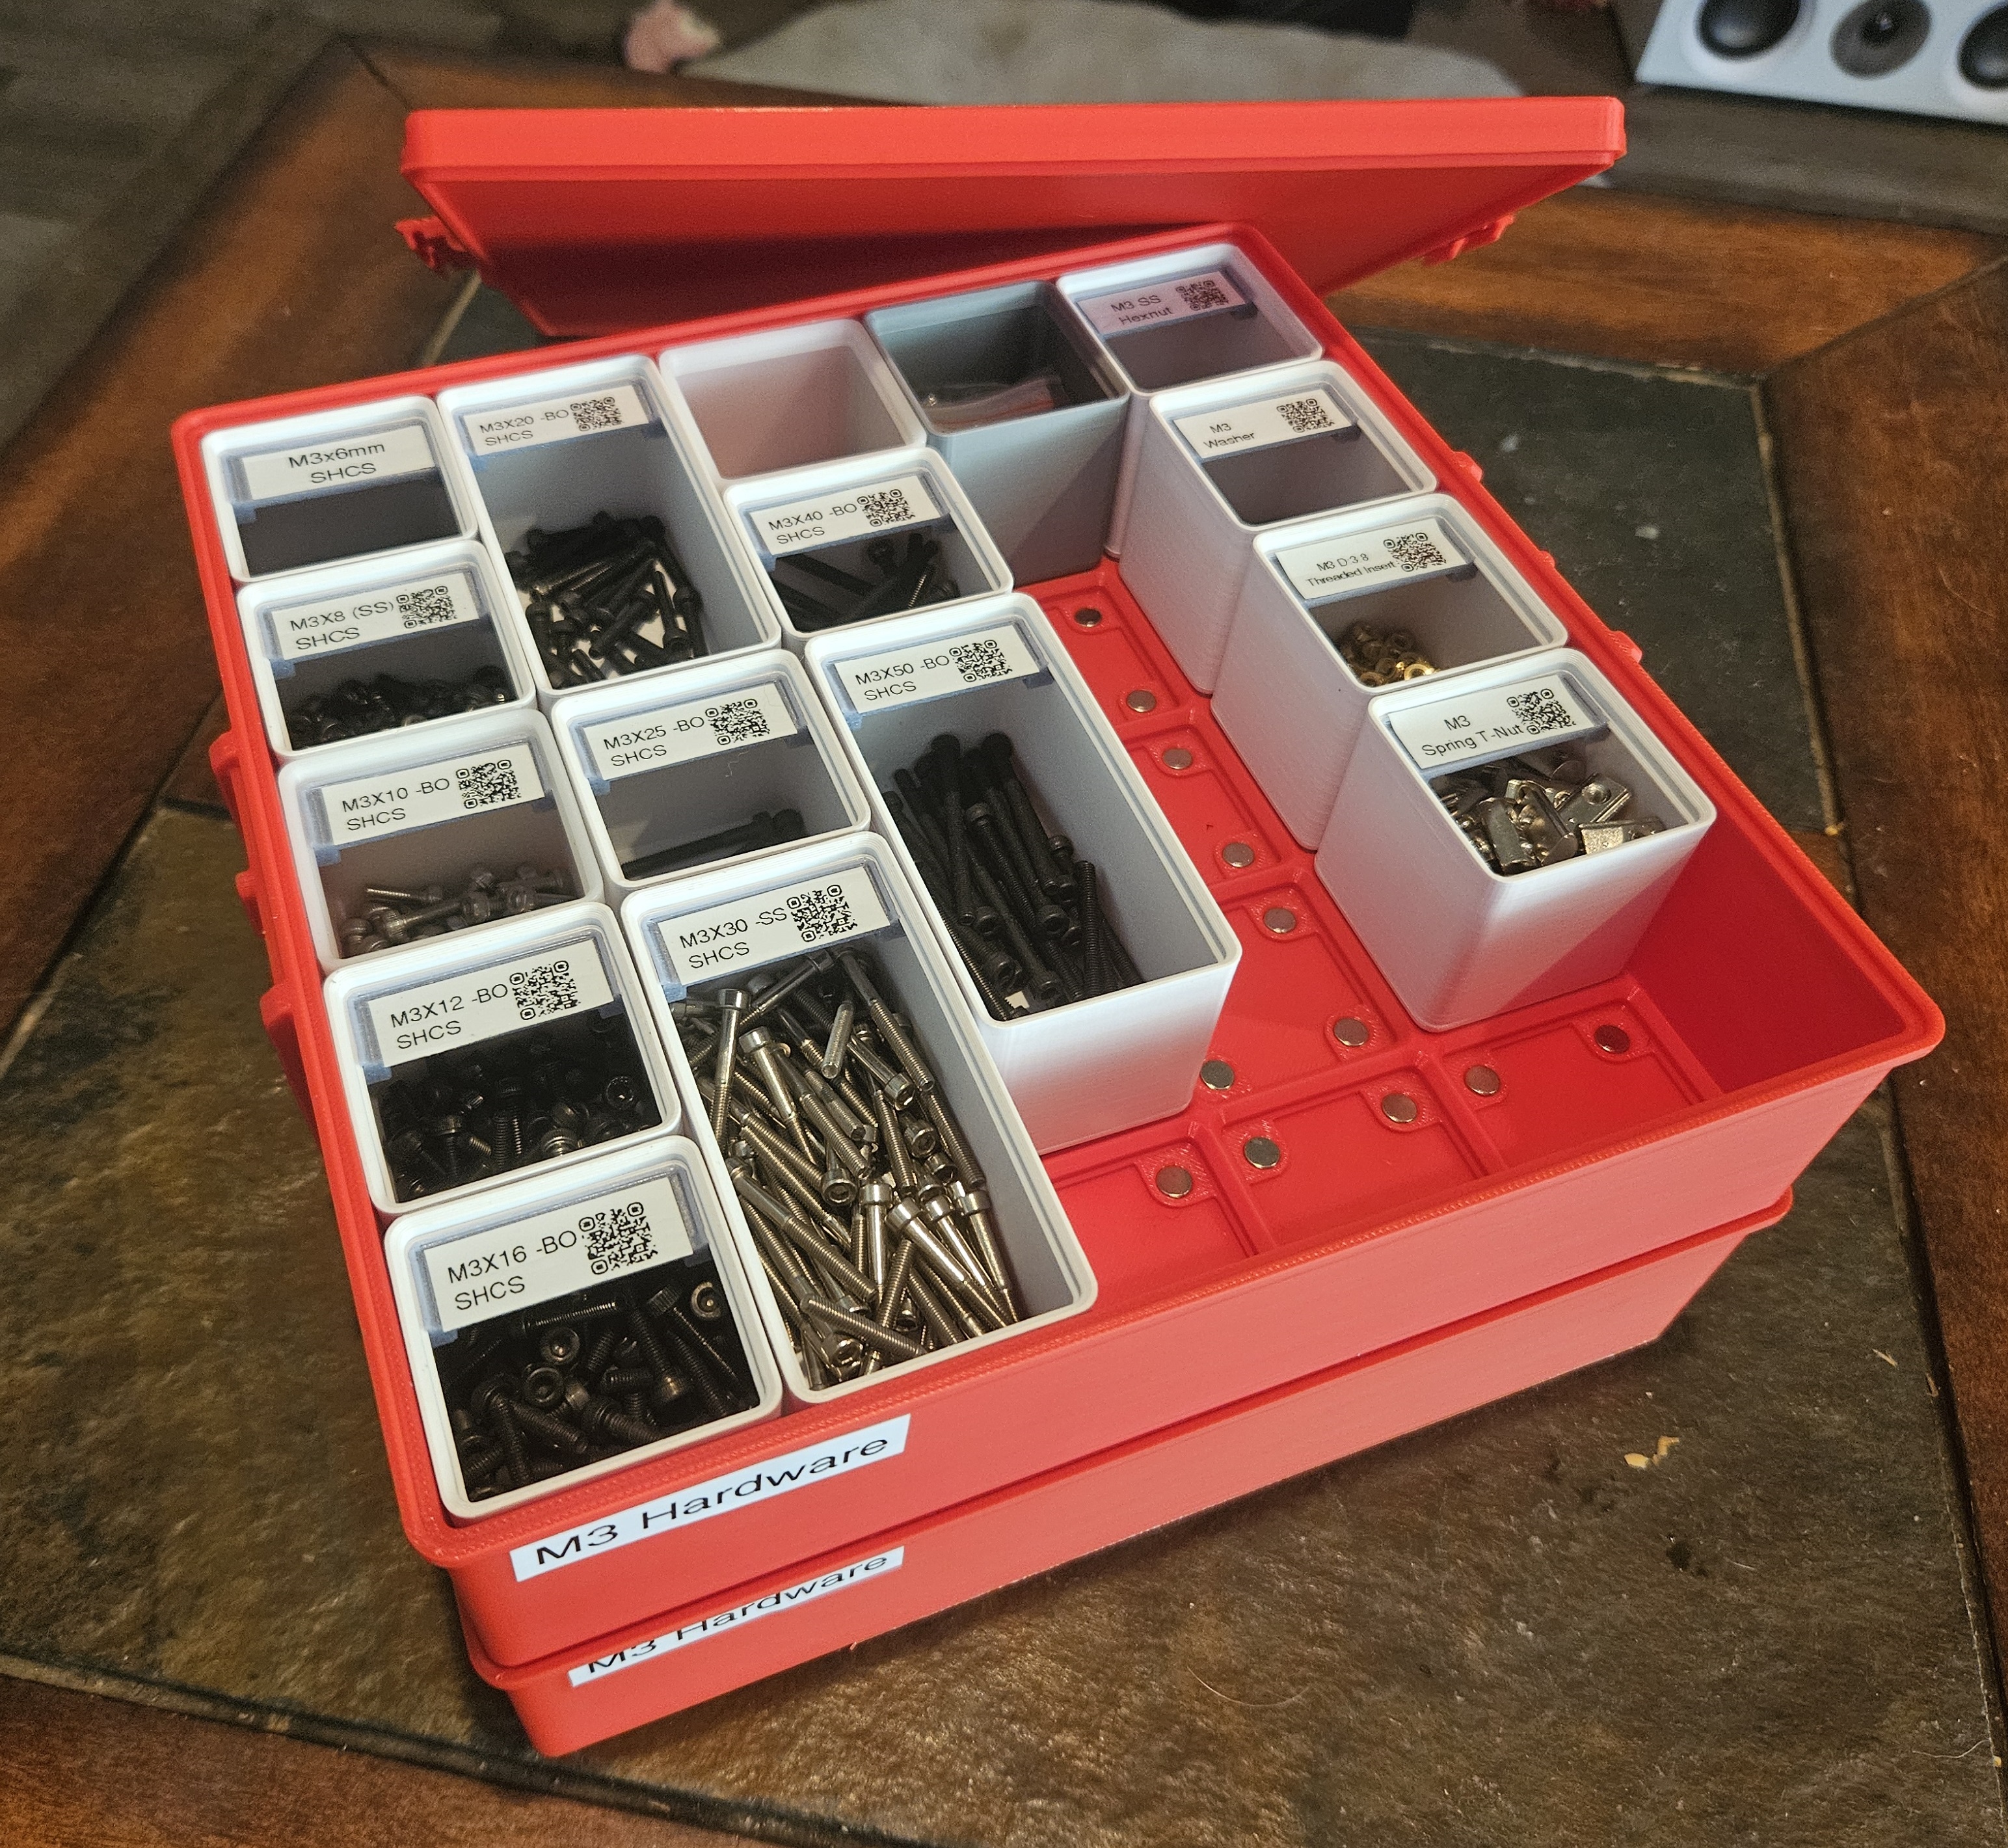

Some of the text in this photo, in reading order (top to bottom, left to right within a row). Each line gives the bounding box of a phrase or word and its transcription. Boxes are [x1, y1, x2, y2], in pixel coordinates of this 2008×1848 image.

[1110, 295, 1161, 312] M3 SS
[1118, 307, 1173, 325] Hexnut
[479, 409, 569, 433] M3X20 -BO
[1209, 423, 1231, 434] M3
[485, 430, 533, 446] SHCS
[1203, 431, 1255, 449] Washer
[289, 444, 386, 468] M3x6mm
[311, 462, 377, 483] SHCS
[768, 503, 857, 531] M3X40 -BO
[777, 526, 825, 544] SHCS
[1307, 561, 1397, 587] Threaded Insert
[1316, 561, 1335, 572] M3
[290, 601, 394, 631] M3X8 (SS)
[296, 627, 360, 650] SHCS
[855, 655, 950, 686] M3X50 -BO
[864, 681, 917, 701] SHCS
[603, 716, 704, 750] M3X25 -BO
[1443, 715, 1471, 730] M3
[1421, 724, 1525, 757] Spring T-Nut
[611, 744, 667, 767] SHCS
[342, 778, 450, 812] M3X10 -BO
[347, 808, 407, 831] SHCS
[679, 907, 788, 949] M3X30 -SS
[689, 942, 750, 969] SHCS
[390, 984, 509, 1028] M3X12 -BO
[397, 1020, 462, 1050] SHCS
[448, 1230, 577, 1283] M3X16 -BO
[455, 1275, 526, 1311] SHCS
[537, 1438, 888, 1564] M3 Hardware
[676, 1556, 888, 1640] Hardware
